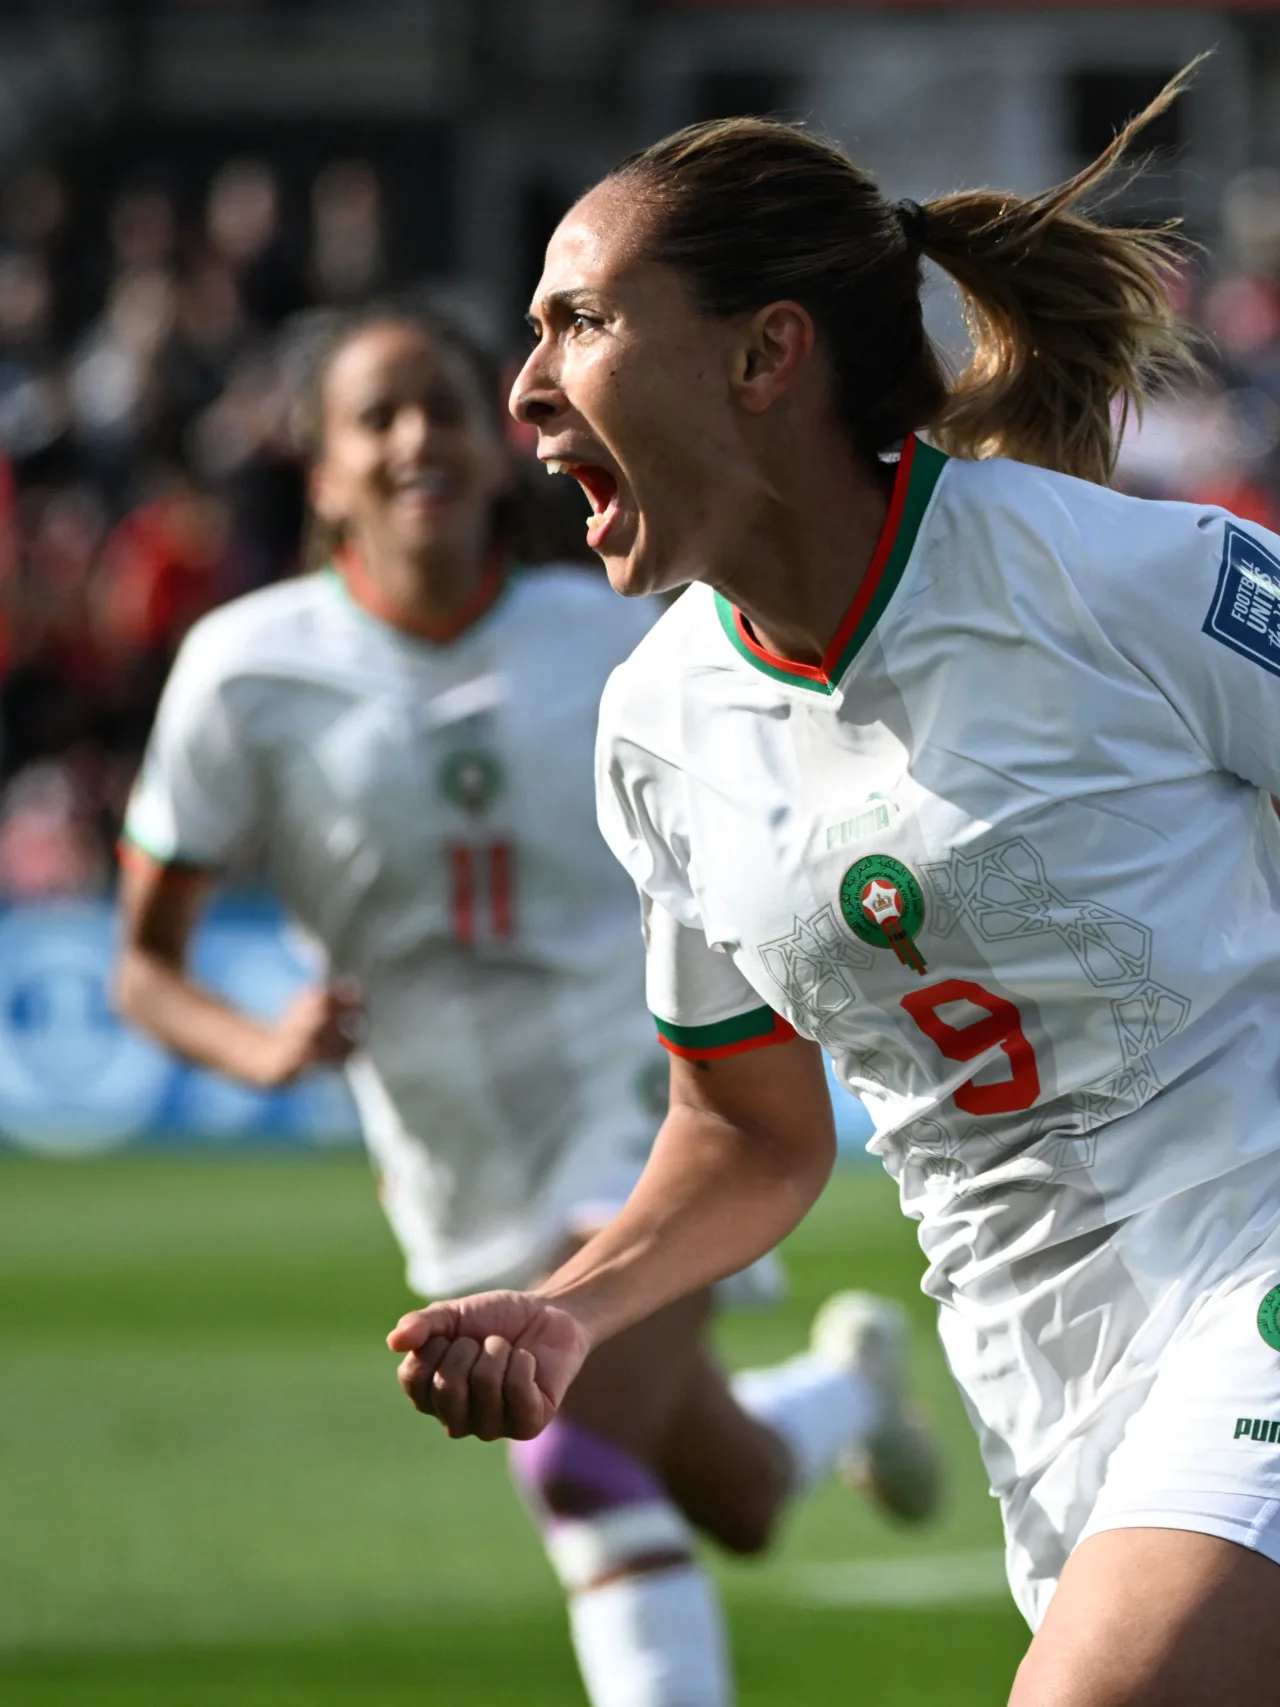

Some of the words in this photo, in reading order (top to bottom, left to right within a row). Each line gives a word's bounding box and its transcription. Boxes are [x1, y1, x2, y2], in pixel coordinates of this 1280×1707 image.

[1231, 558, 1255, 623] FOOTBLL
[1246, 566, 1276, 634] UNITS
[449, 842, 509, 942] 11
[900, 978, 1041, 1116] 9
